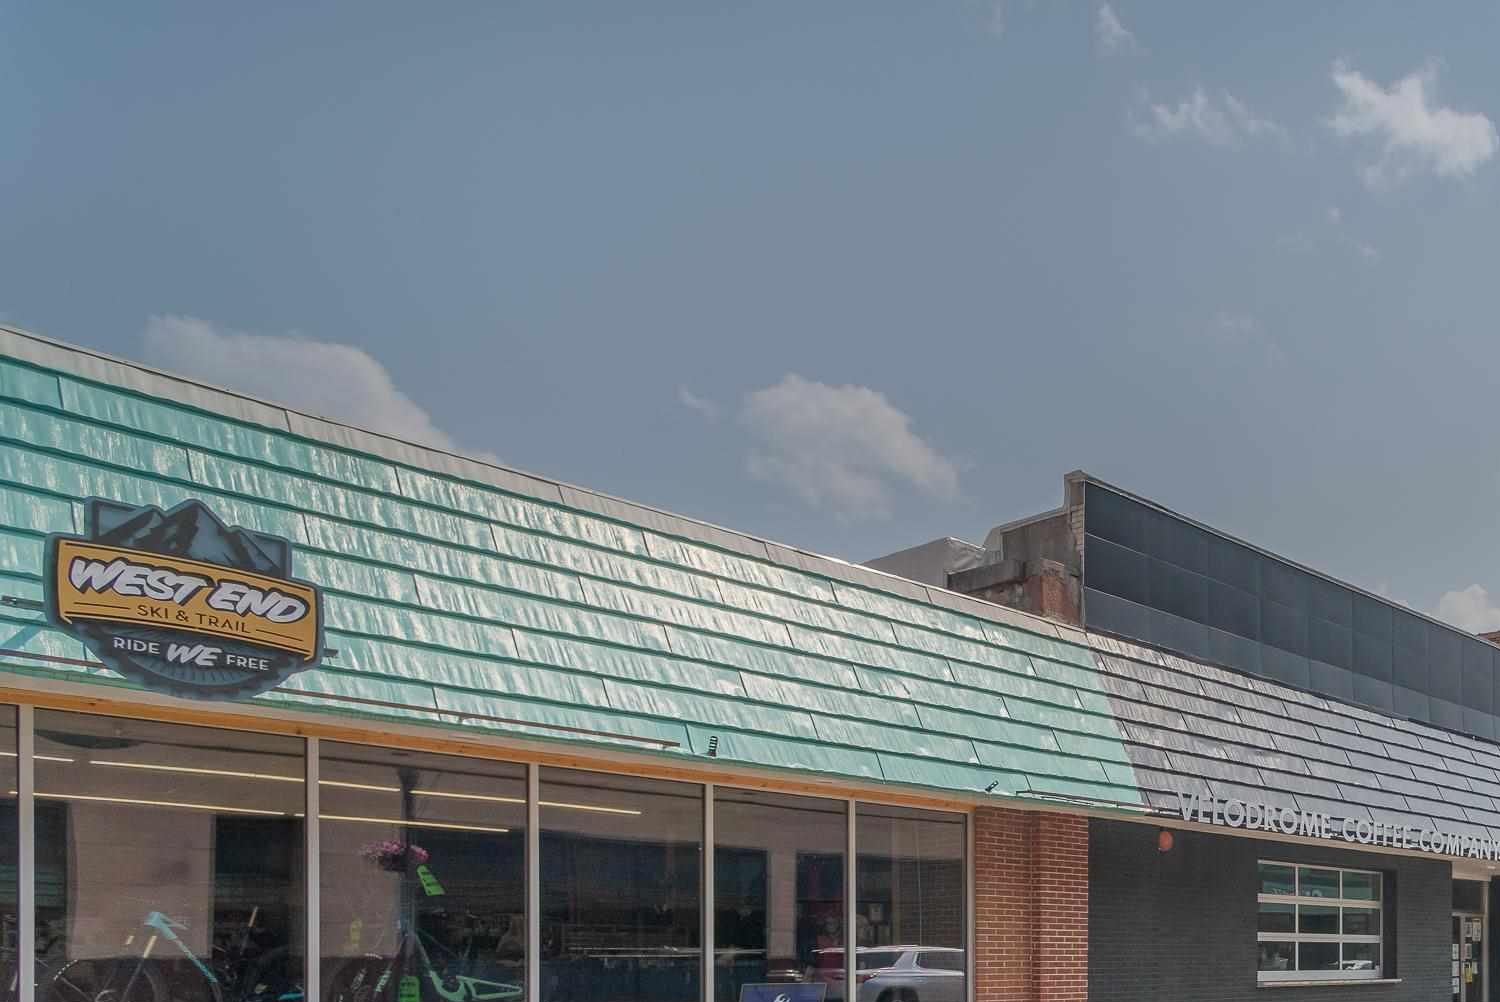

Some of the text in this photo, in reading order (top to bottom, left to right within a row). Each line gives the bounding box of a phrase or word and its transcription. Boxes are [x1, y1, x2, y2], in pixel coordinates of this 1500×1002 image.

[69, 557, 310, 624] WEST END
[137, 604, 251, 633] SKI & TRAIL
[113, 637, 271, 670] RIDE WE FREE
[1178, 790, 1500, 861] VELODROME COFFEE COMPANY
